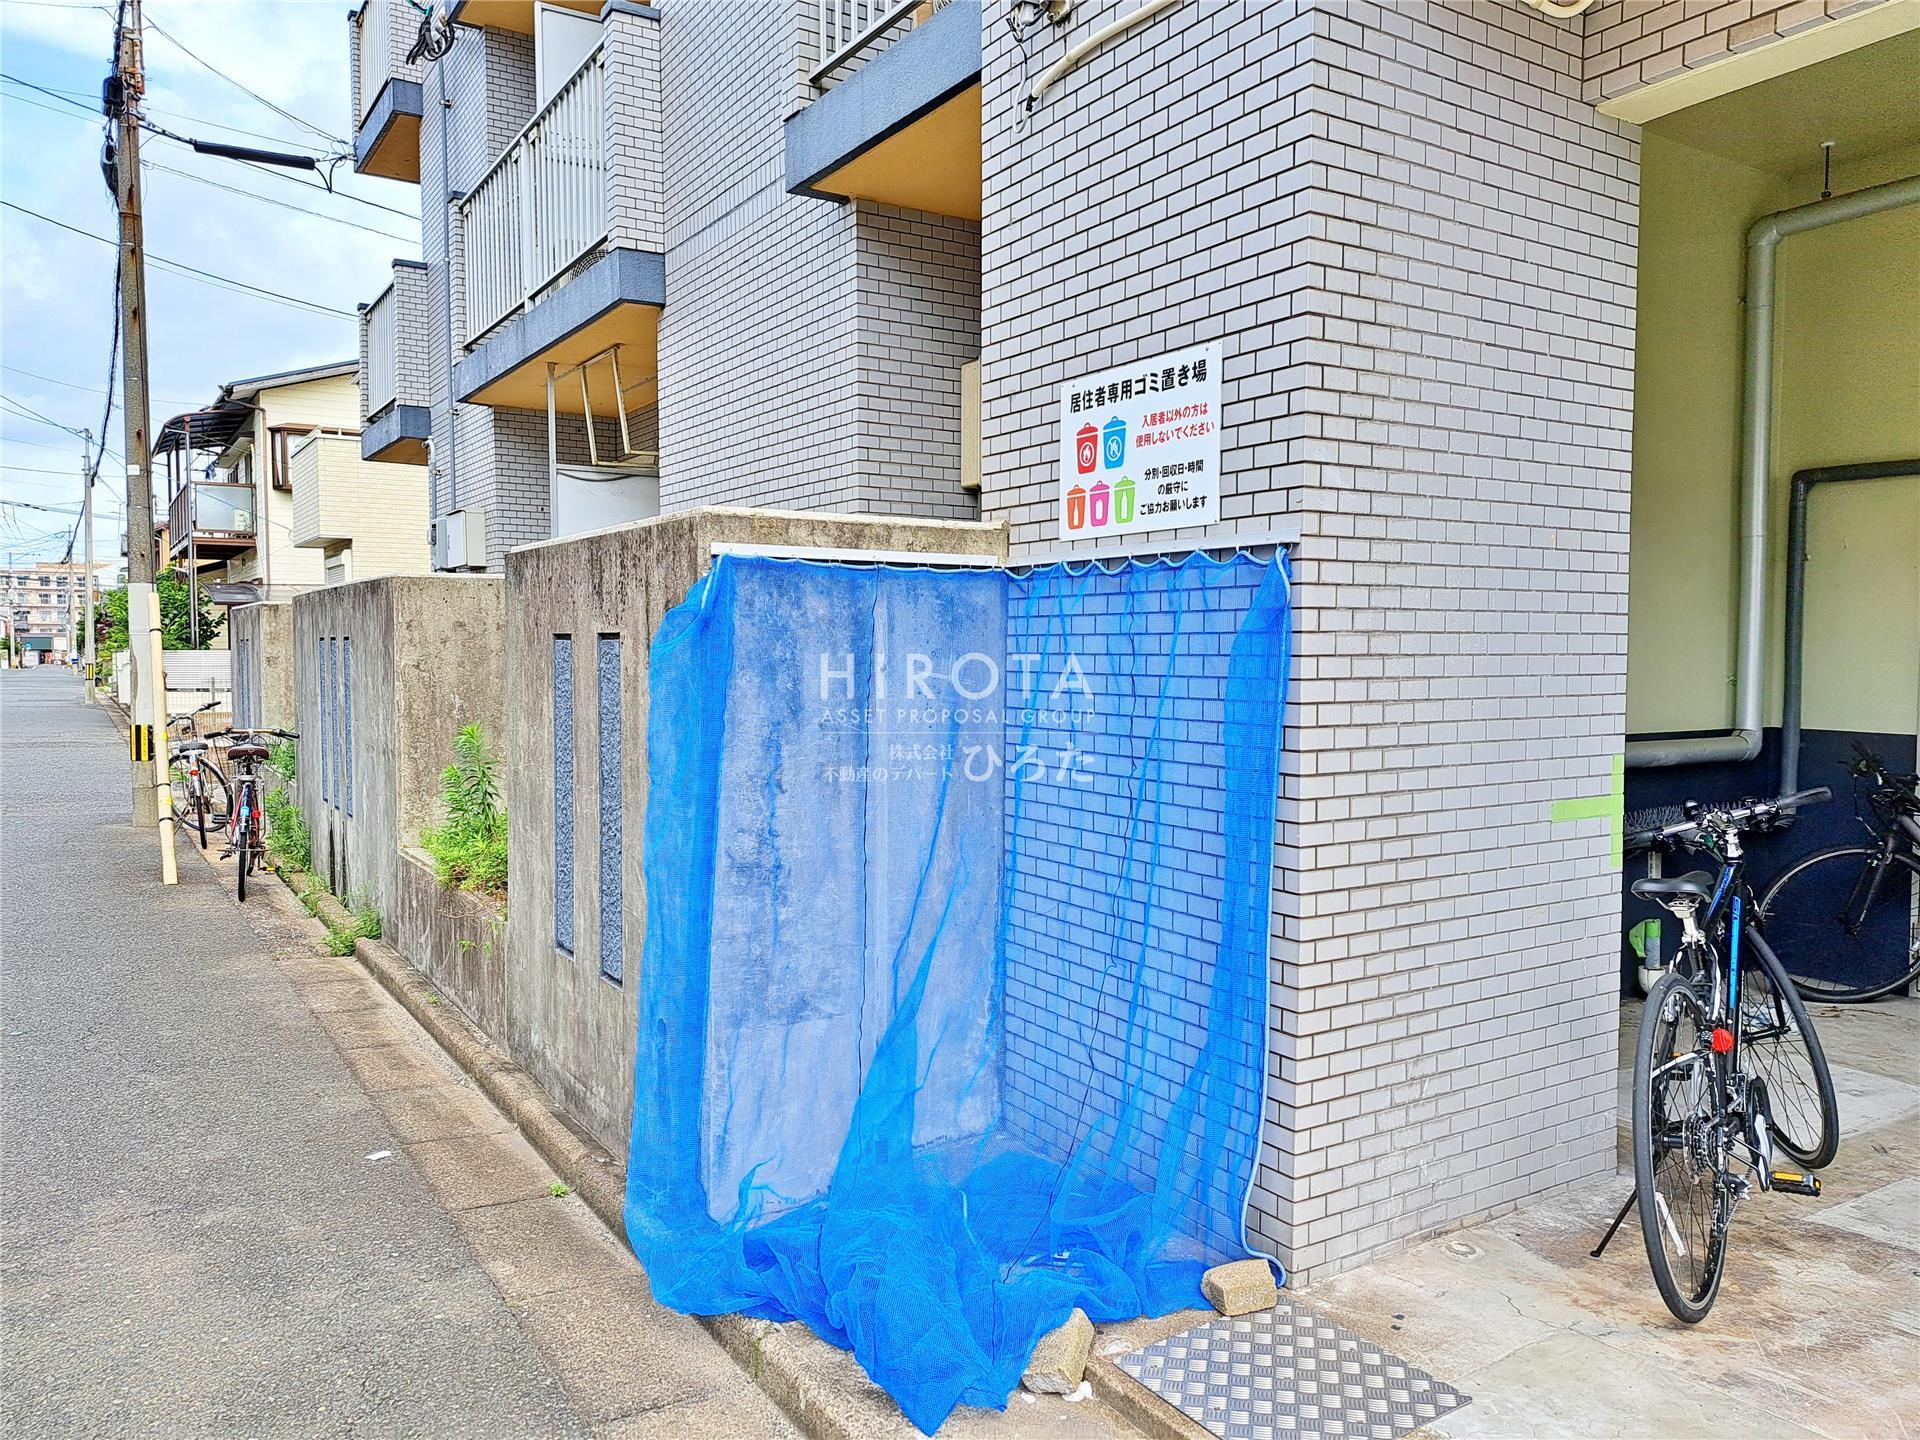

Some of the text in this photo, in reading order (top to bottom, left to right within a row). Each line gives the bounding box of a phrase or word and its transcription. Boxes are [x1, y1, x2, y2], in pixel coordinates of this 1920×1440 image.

[1070, 359, 1208, 414] 居住者専用ゴミ置き場
[1142, 402, 1209, 428] 入居者以外の方は
[1136, 421, 1215, 448] 使用しないでください
[1157, 481, 1188, 495] の厳守に
[1140, 495, 1208, 515] ご協力お願いします
